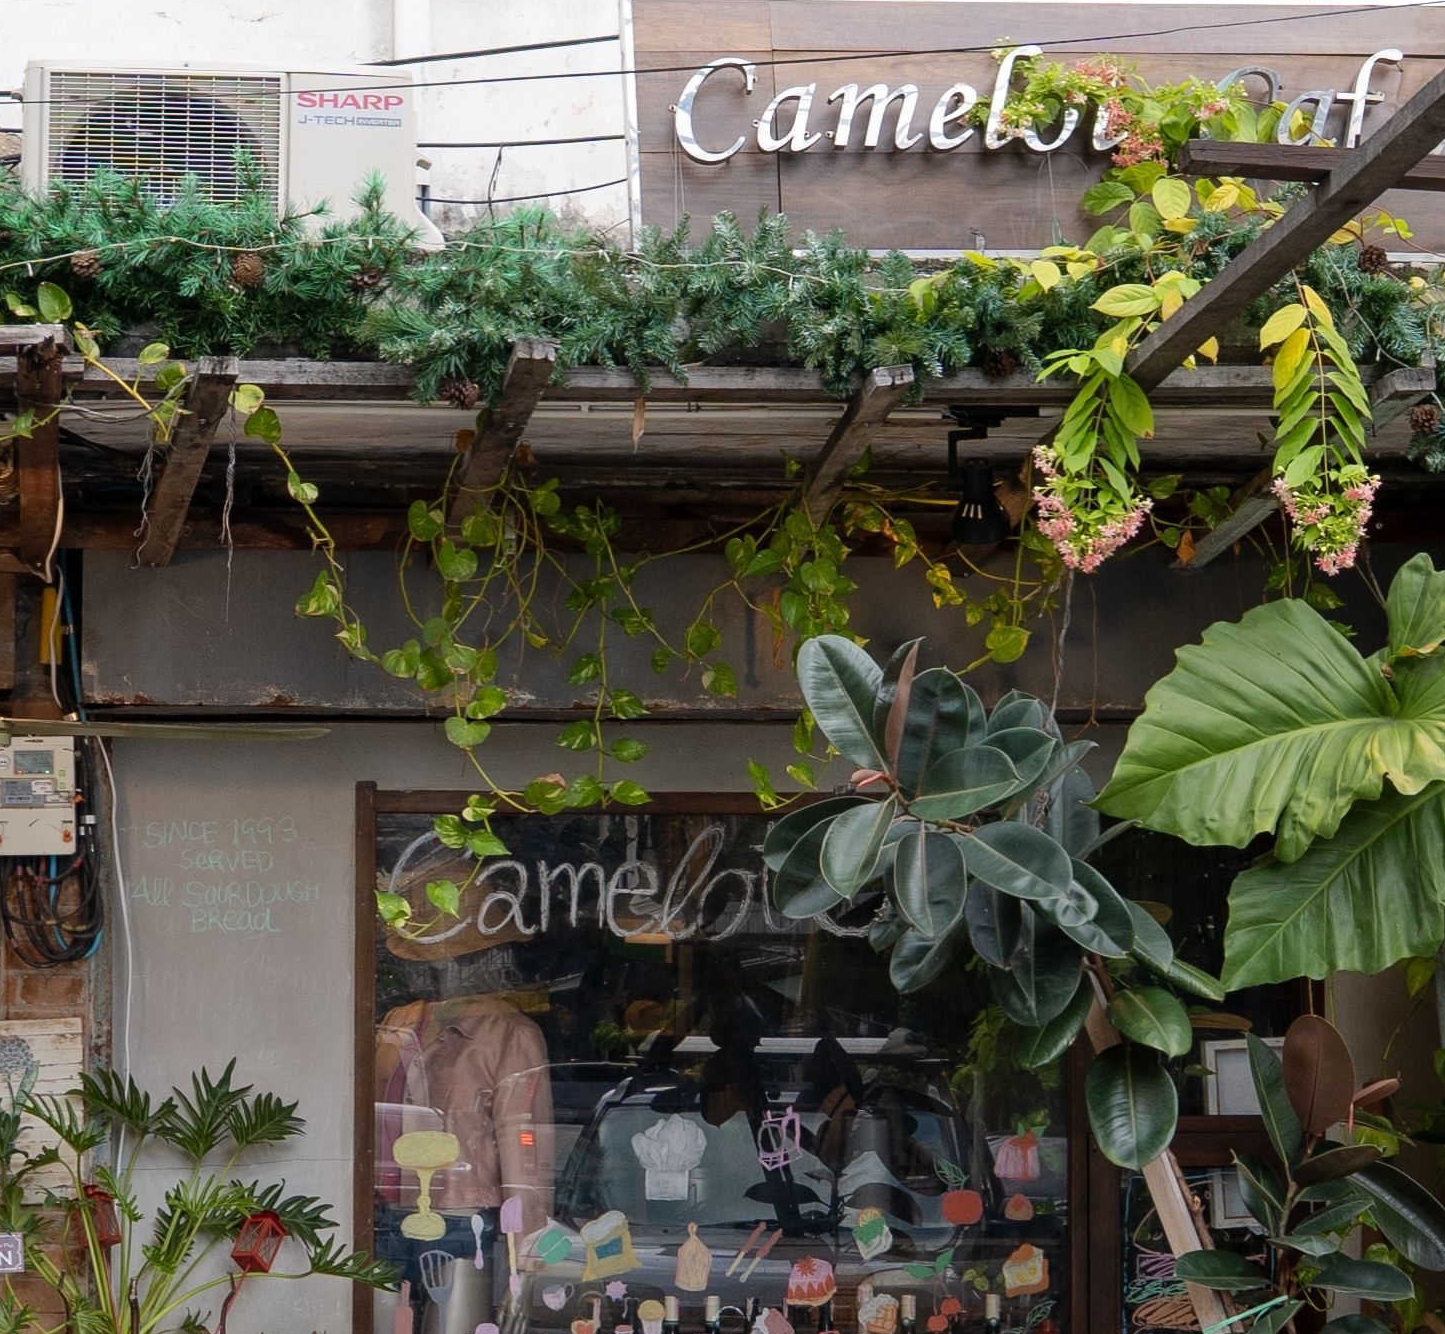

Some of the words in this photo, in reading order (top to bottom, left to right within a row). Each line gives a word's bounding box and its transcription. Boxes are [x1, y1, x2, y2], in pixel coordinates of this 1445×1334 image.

[296, 92, 404, 111] SHARP
[1201, 48, 1404, 148] af
[297, 115, 355, 126] J-TECH
[143, 820, 219, 849] SINCE
[228, 816, 299, 845] 1993
